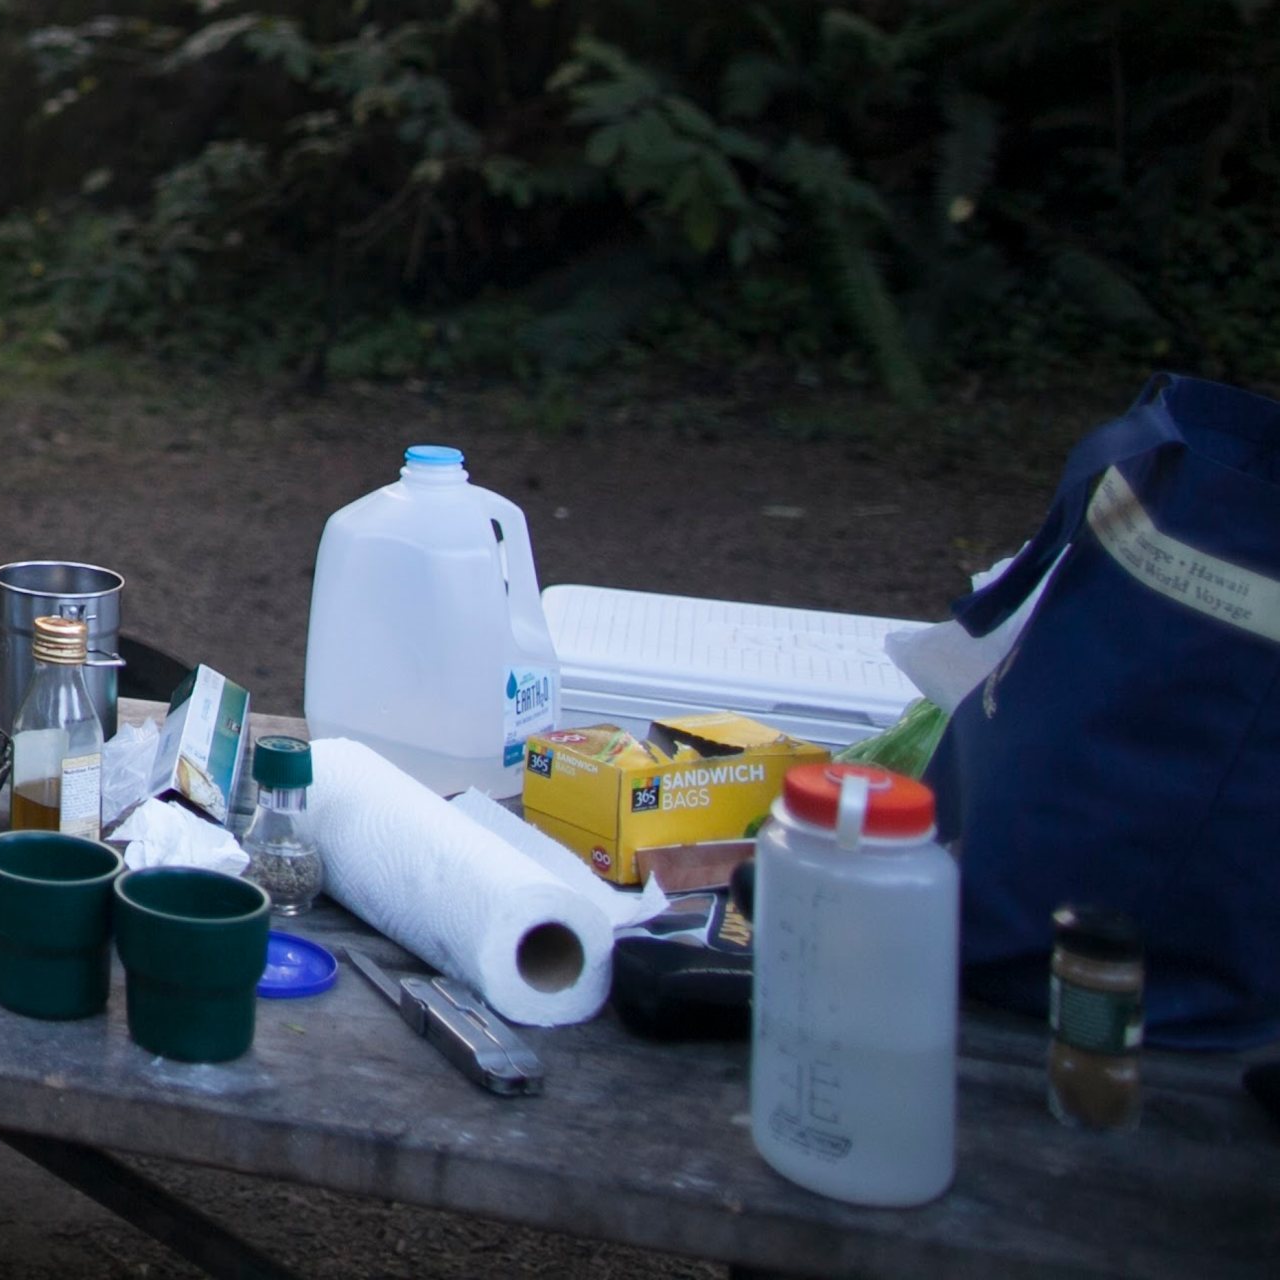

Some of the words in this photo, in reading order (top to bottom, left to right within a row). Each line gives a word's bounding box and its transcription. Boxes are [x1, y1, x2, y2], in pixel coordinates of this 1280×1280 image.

[1144, 561, 1189, 593] World
[1195, 586, 1253, 619] Voyage
[531, 754, 549, 772] 365
[556, 752, 599, 773] SANDWICH
[662, 763, 765, 790] SANDWICH
[635, 789, 656, 807] 365
[662, 788, 710, 811] BAGS
[592, 850, 611, 866] 100
